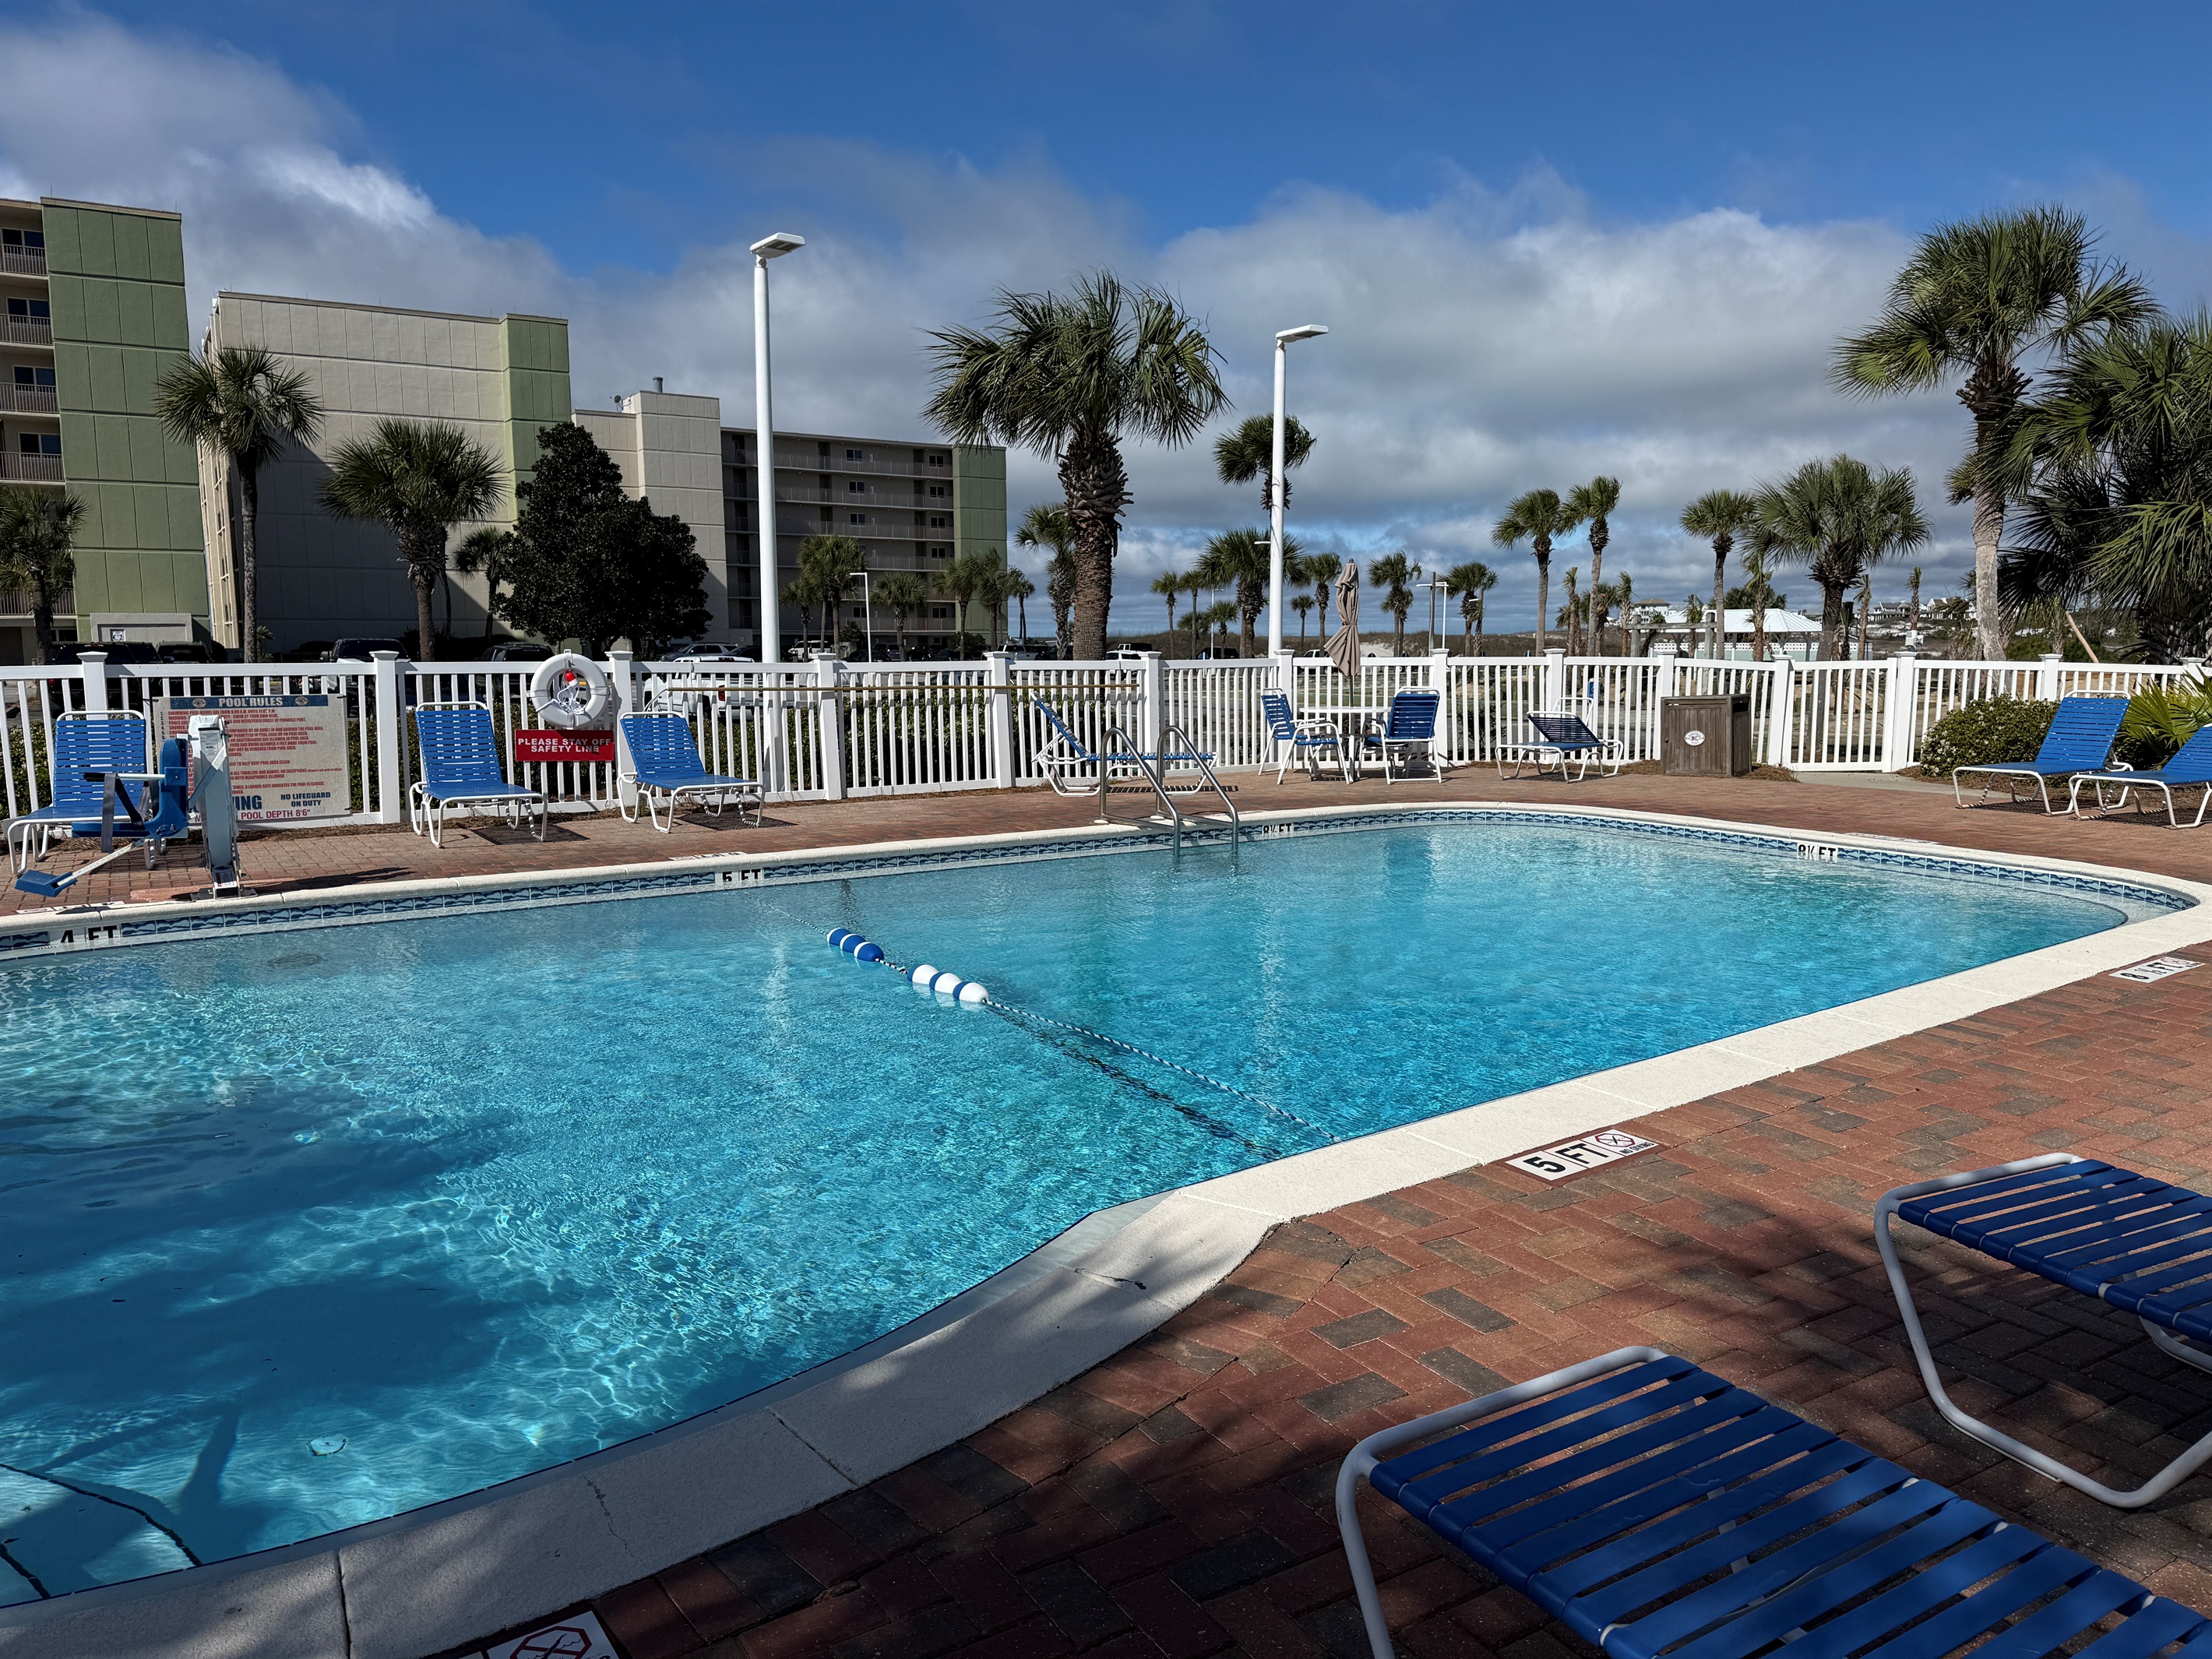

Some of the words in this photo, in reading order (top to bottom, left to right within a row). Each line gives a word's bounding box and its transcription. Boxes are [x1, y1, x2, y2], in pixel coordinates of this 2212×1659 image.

[219, 698, 247, 707] POOL
[250, 697, 283, 706] RULES
[233, 795, 262, 810] ING
[241, 812, 263, 820] POOL
[266, 810, 293, 818] DEPTH
[741, 869, 761, 880] FT
[88, 925, 117, 940] FT
[1523, 1156, 1566, 1173] 5
[1555, 1143, 1610, 1164] FT
